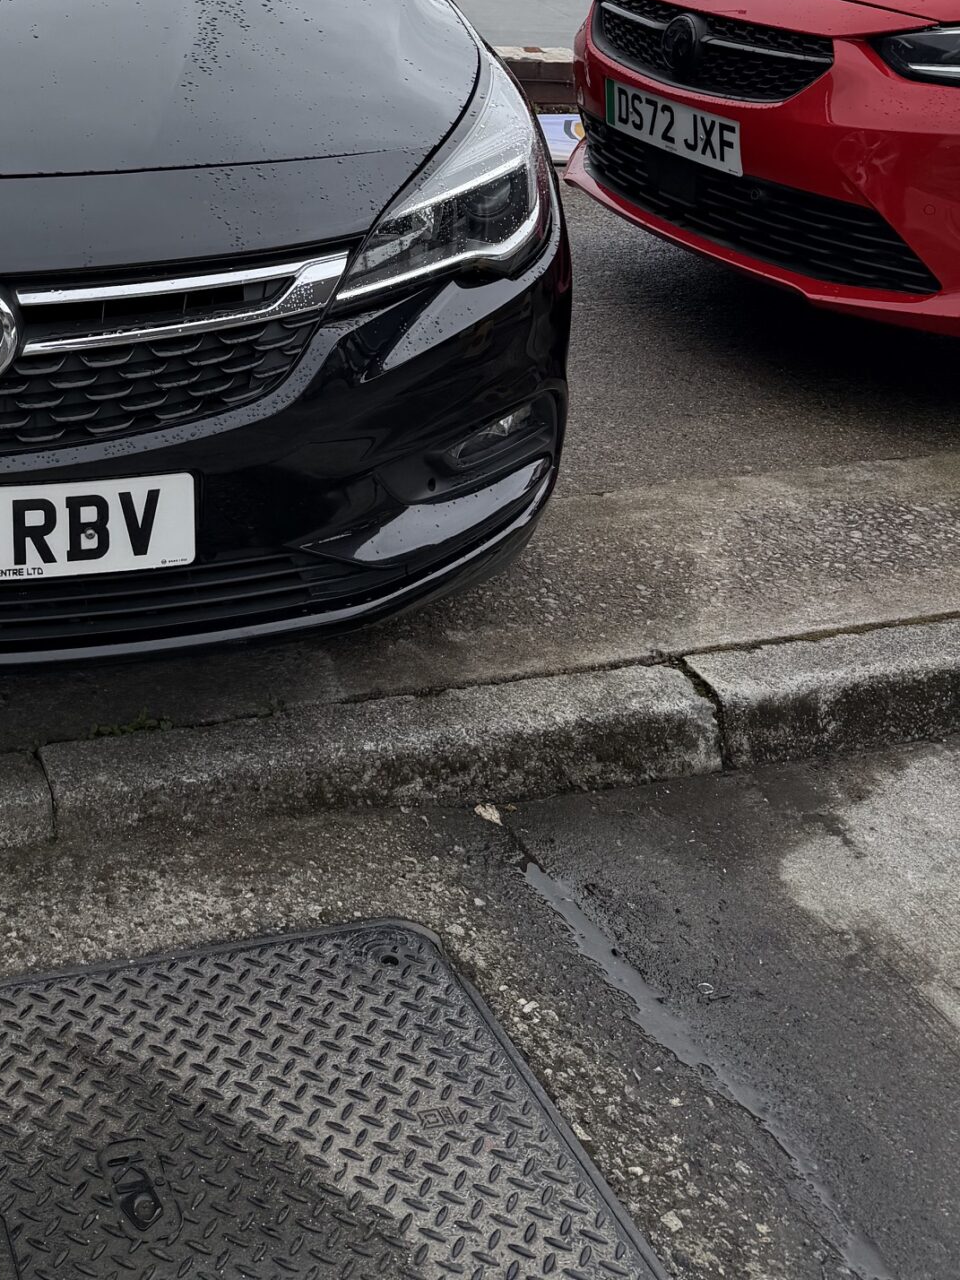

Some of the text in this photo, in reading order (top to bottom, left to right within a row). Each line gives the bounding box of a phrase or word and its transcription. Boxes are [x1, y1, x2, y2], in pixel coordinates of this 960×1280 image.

[617, 86, 736, 163] DS72 JXF
[12, 488, 161, 566] RBV
[26, 567, 44, 576] LTD
